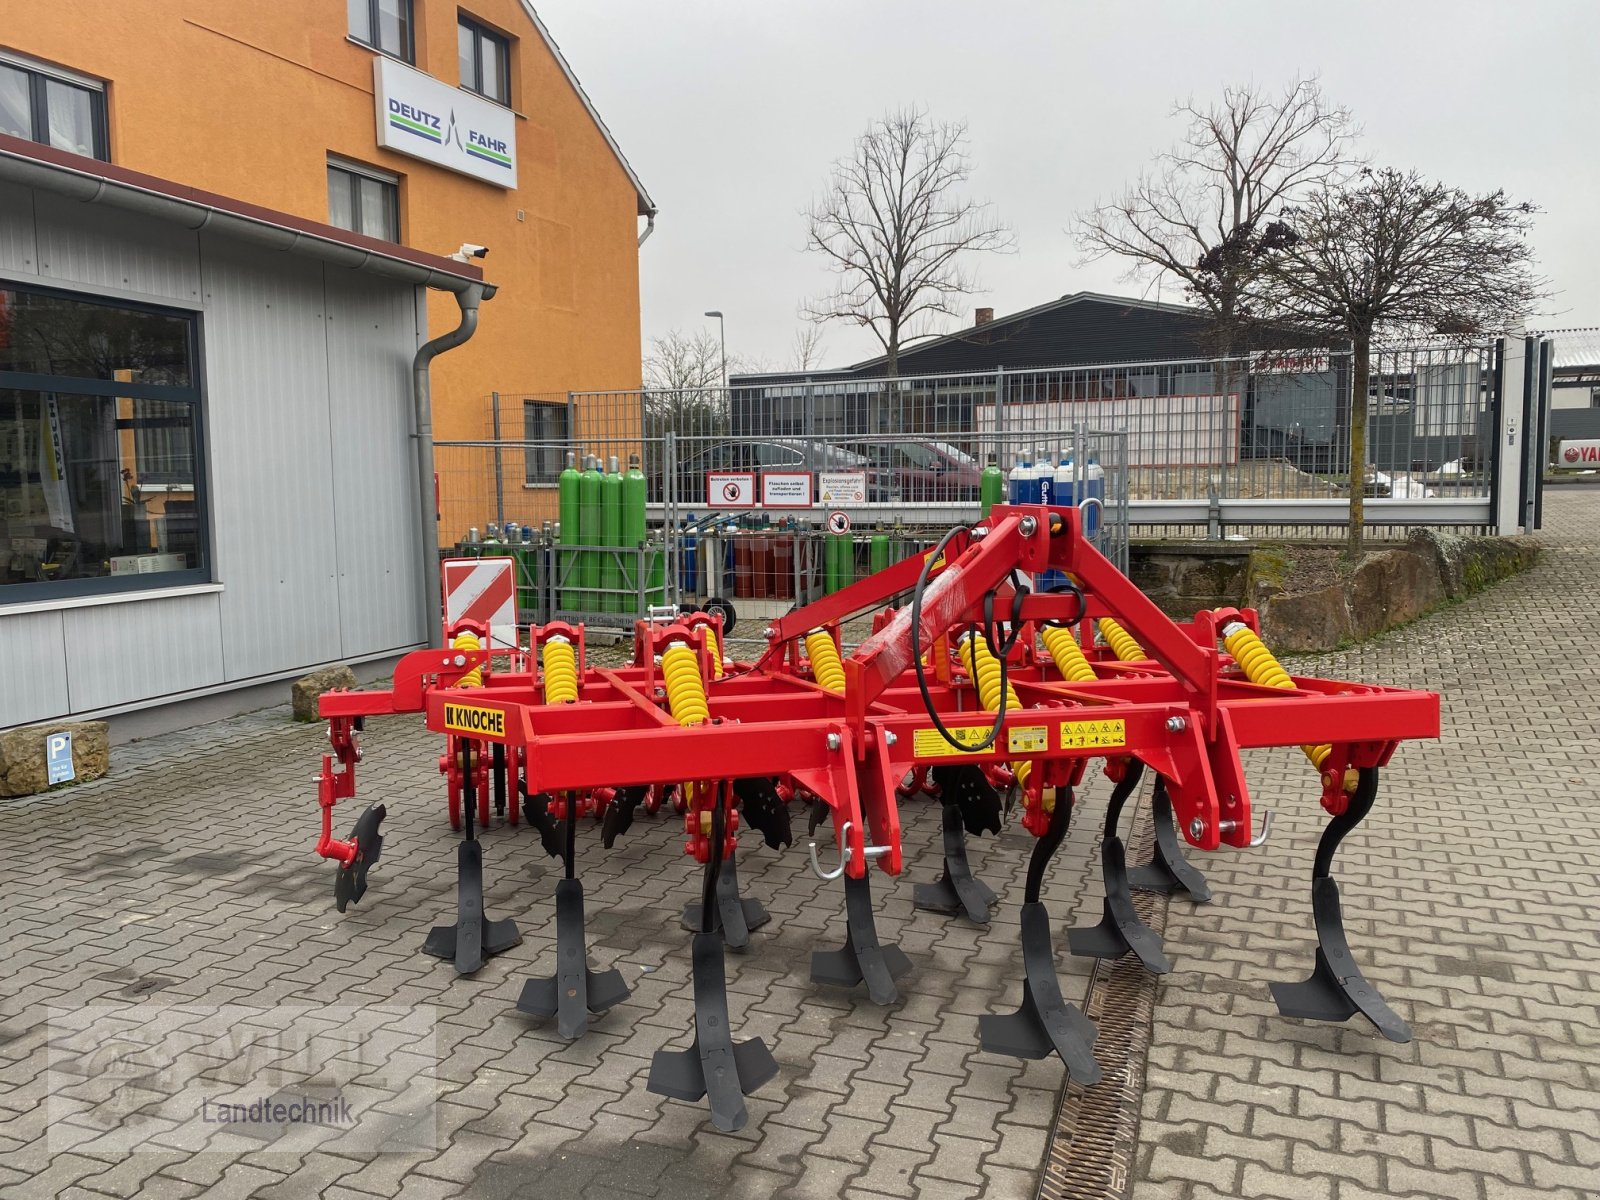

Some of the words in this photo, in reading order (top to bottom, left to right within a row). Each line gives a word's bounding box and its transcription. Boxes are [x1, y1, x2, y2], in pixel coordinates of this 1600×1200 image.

[388, 97, 441, 130] DEUTZ
[469, 129, 507, 155] FAHR
[1580, 446, 1600, 462] YA
[456, 707, 503, 733] KNOCHE
[51, 737, 66, 760] P
